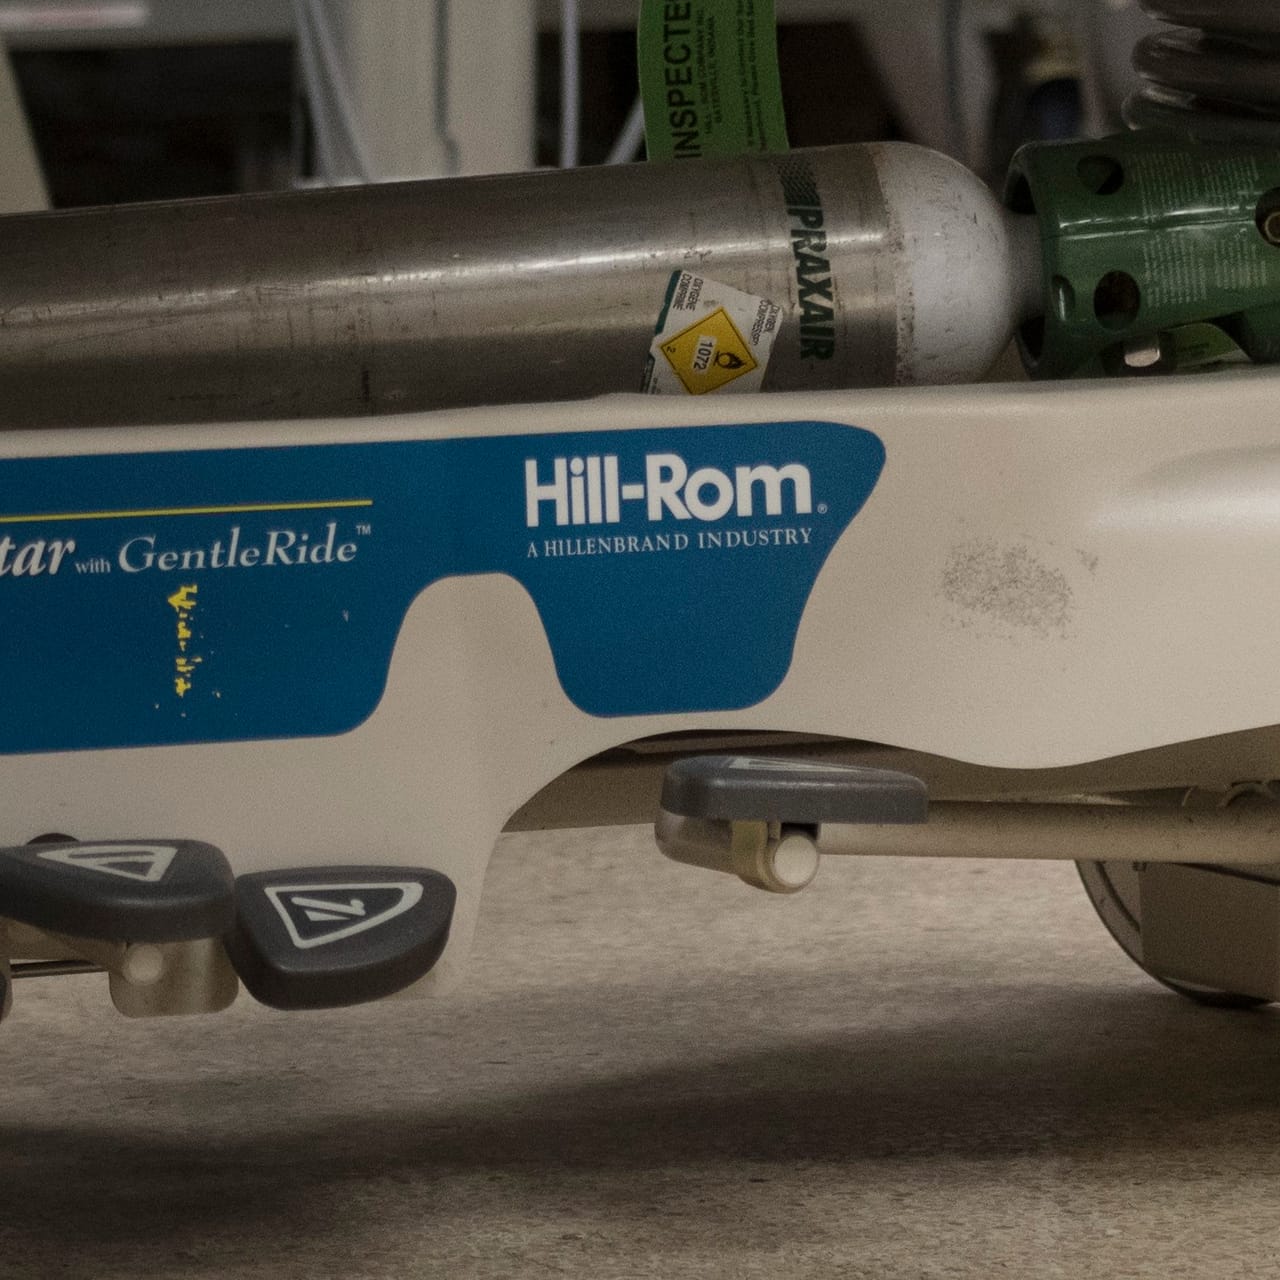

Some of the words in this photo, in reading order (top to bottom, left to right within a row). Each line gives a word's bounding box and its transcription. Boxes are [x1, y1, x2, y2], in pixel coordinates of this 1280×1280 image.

[788, 207, 835, 361] PRAXAIR
[693, 341, 713, 371] 1072
[527, 541, 538, 558] A
[544, 532, 689, 557] HILLENBRAND
[698, 527, 813, 549] INDUSTRY
[75, 558, 112, 575] with
